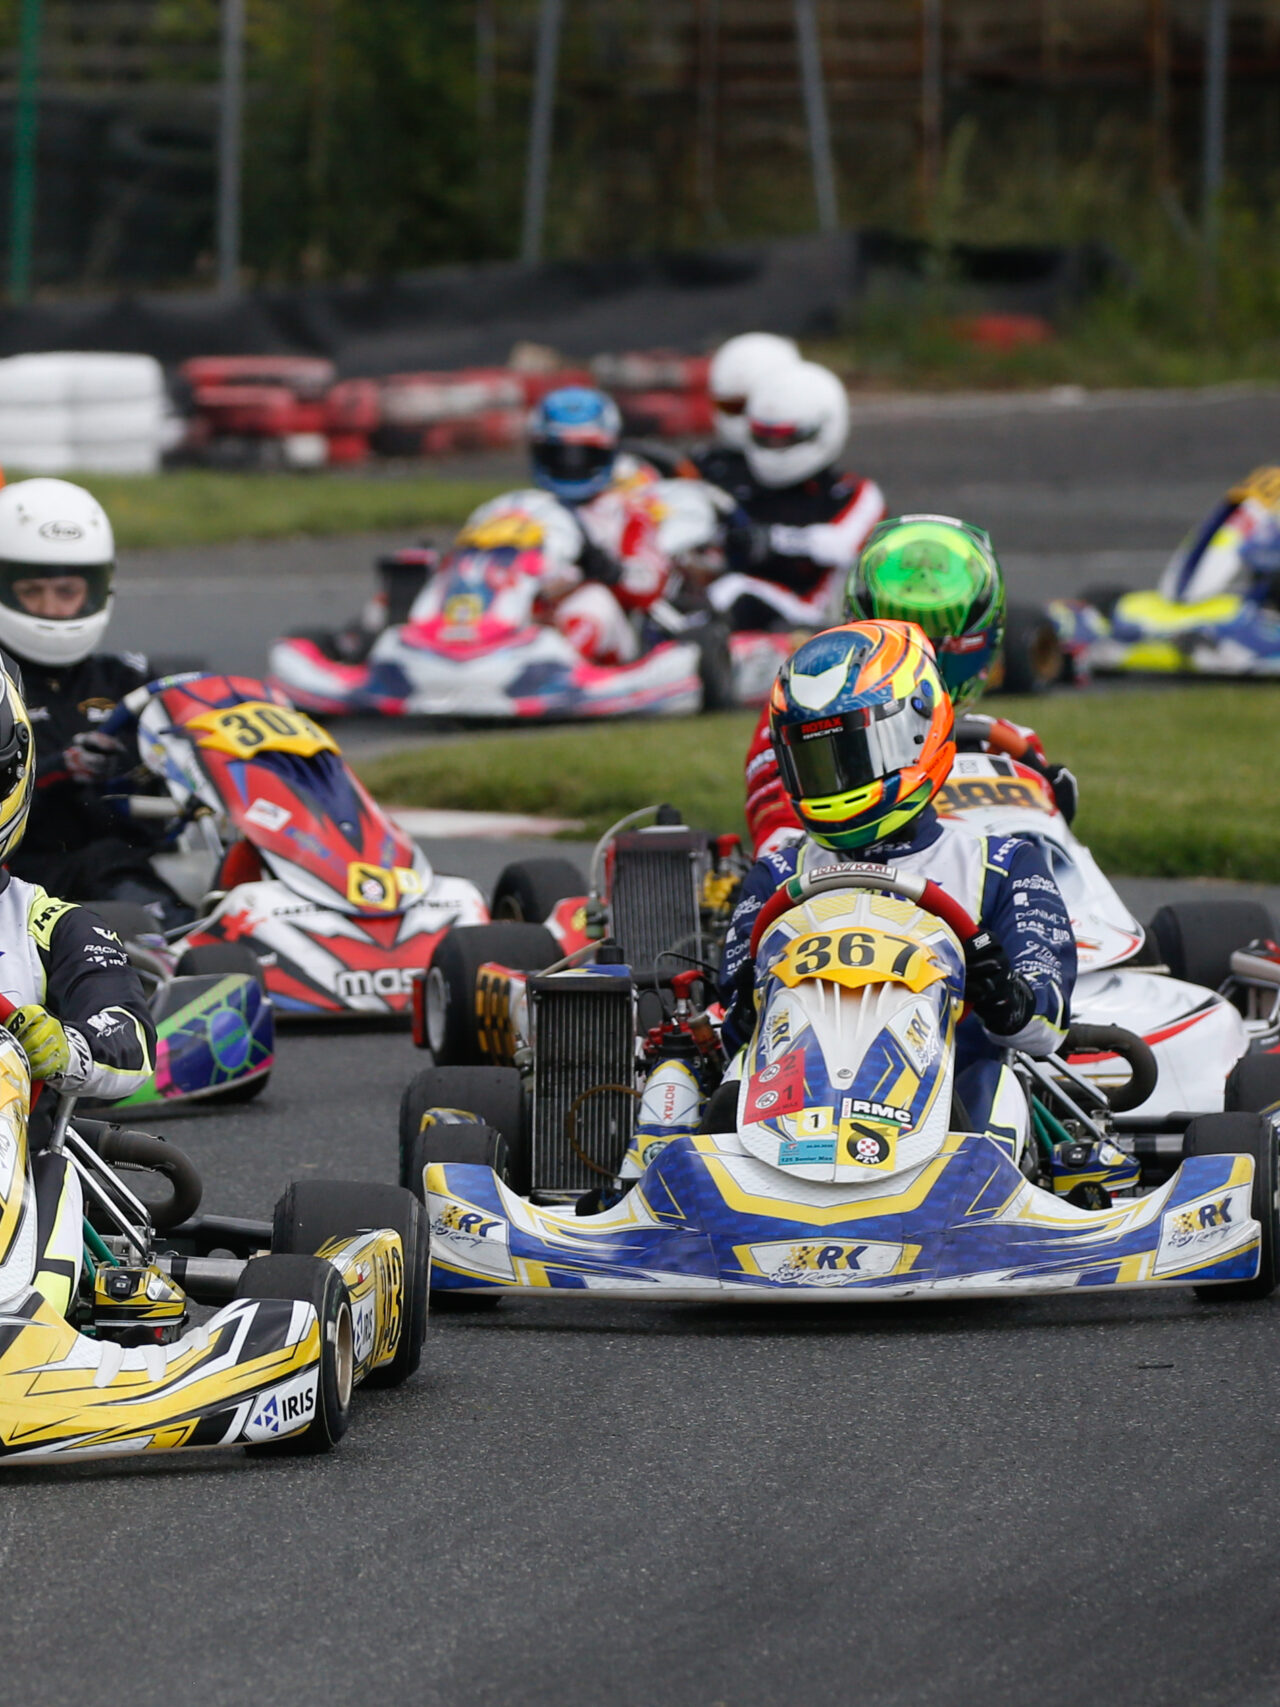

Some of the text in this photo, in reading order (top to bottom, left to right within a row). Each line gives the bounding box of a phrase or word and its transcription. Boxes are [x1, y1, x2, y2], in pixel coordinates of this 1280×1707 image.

[801, 717, 842, 733] ROTAX
[795, 932, 920, 977] 367
[663, 1084, 676, 1121] ROTAX
[783, 1085, 793, 1101] 1
[810, 1113, 820, 1128] 1
[853, 1100, 911, 1123] RMC
[855, 1154, 880, 1164] PZM
[281, 1386, 314, 1421] IRIS
